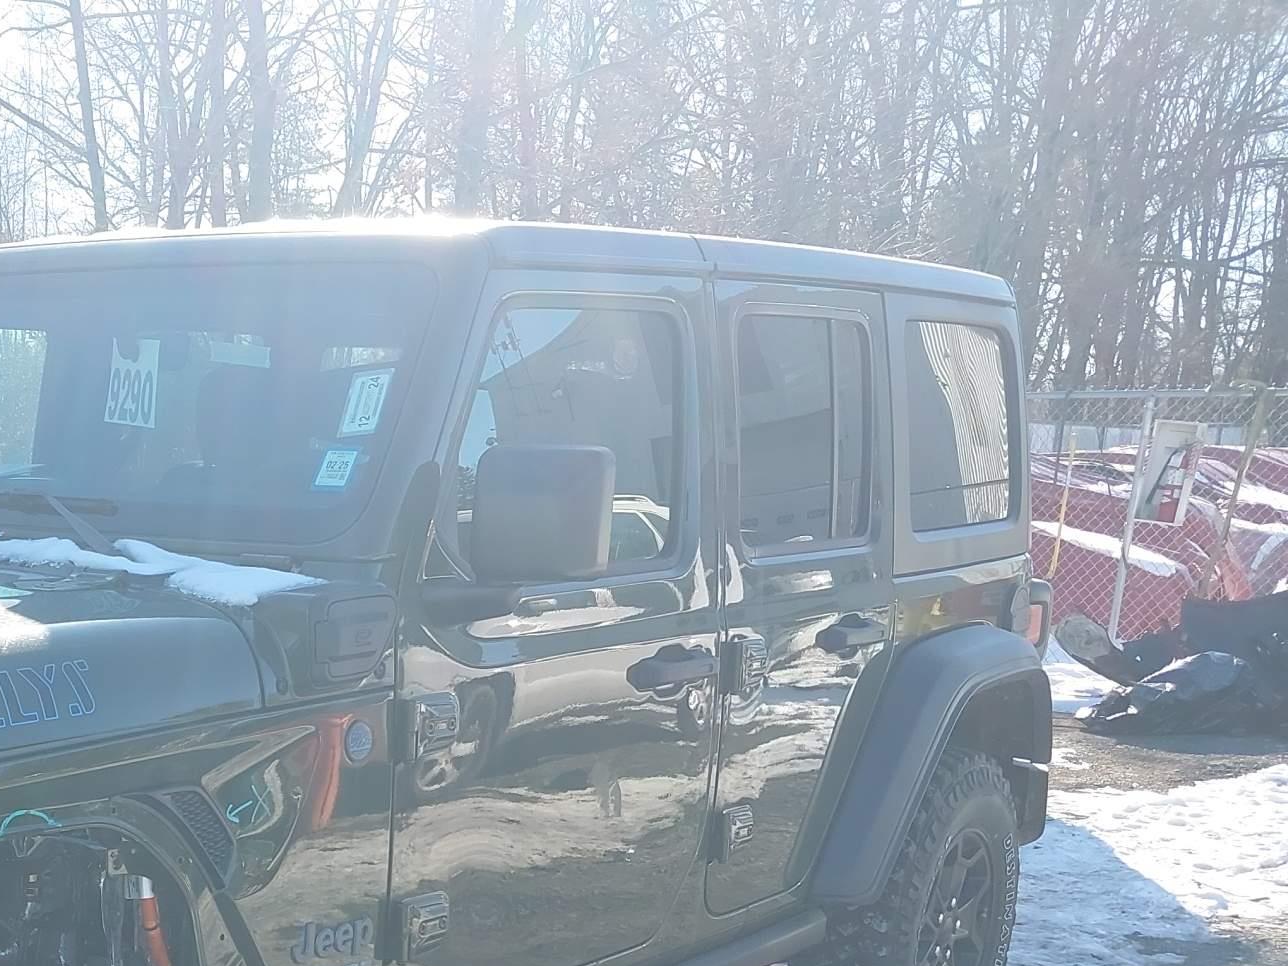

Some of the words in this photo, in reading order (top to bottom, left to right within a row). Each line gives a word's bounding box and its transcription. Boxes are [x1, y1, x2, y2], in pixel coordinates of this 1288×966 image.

[106, 366, 155, 425] 9290
[358, 415, 370, 427] 12
[368, 376, 381, 389] 24
[290, 917, 373, 964] Jeep
